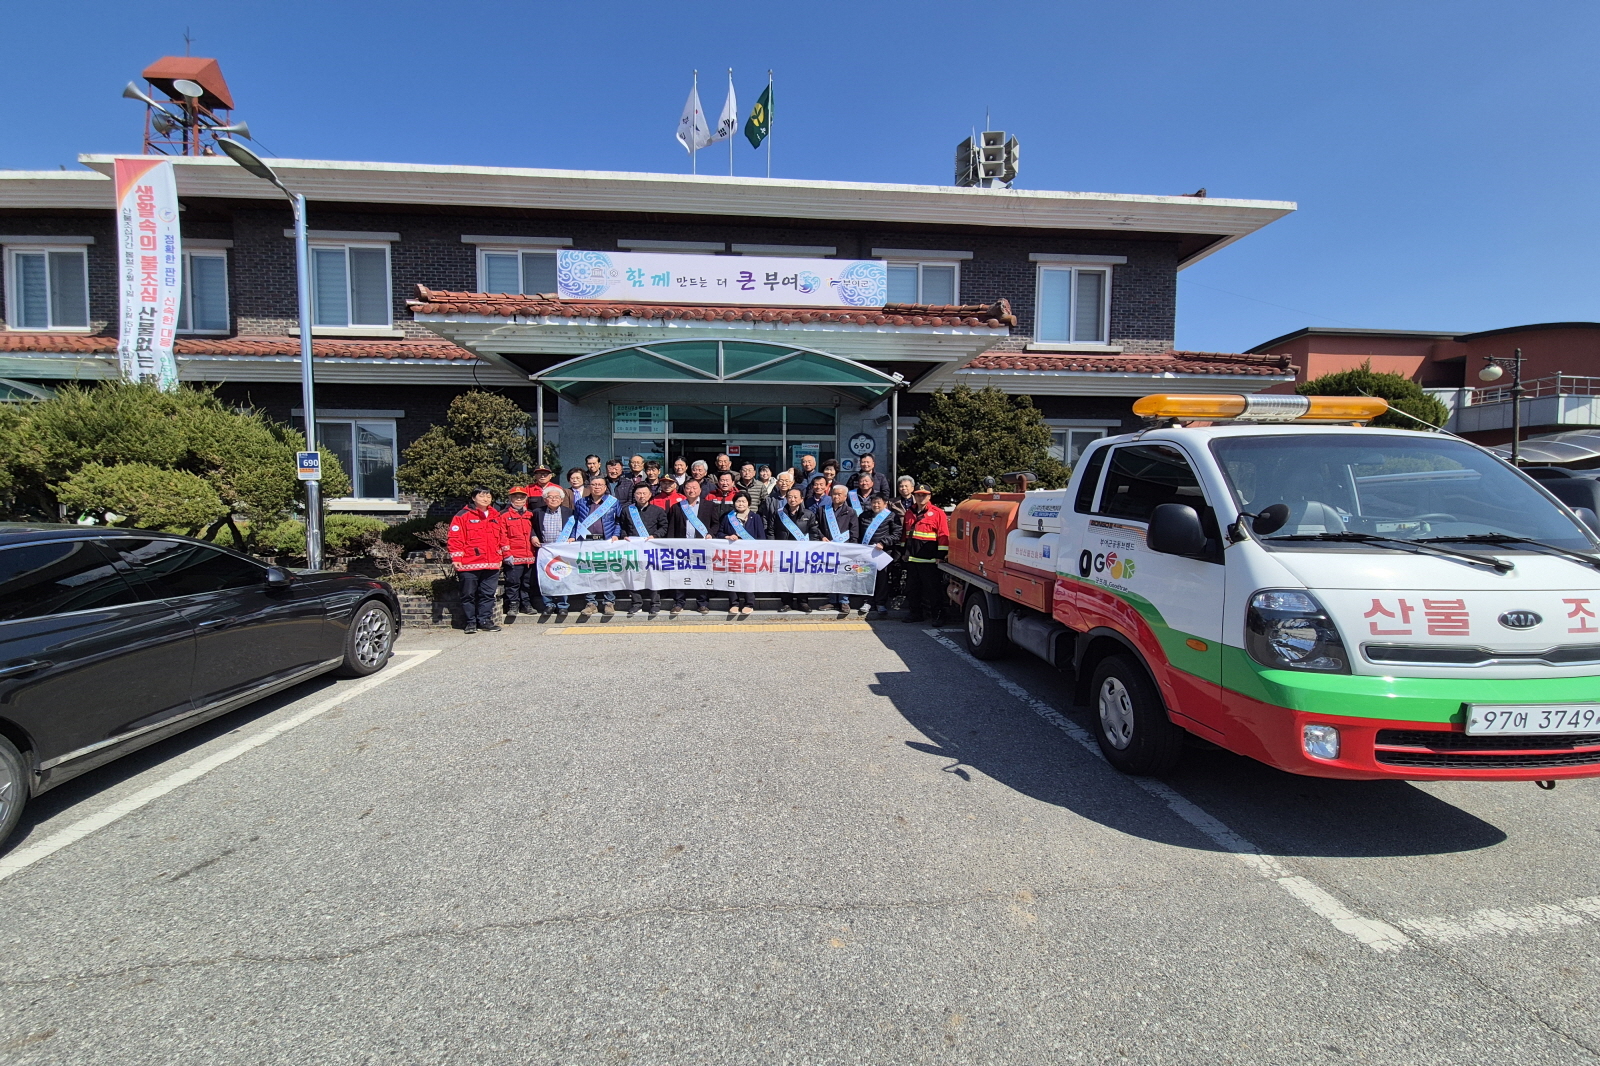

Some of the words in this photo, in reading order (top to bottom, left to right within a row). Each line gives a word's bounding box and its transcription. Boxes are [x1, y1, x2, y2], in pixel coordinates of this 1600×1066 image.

[134, 185, 158, 251] 생활속의
[164, 234, 175, 264] 정확한
[140, 255, 158, 303] 불조심
[164, 267, 175, 287] 판단
[625, 267, 671, 288] 함께
[676, 276, 708, 288] 만드는
[716, 277, 727, 288] 더
[736, 270, 757, 291] 큰
[763, 271, 799, 291] 부여
[162, 297, 175, 325] 신속한
[136, 306, 158, 368] 산불없는
[159, 328, 173, 348] 대응
[853, 442, 871, 450] 690
[303, 459, 318, 467] 690
[575, 549, 640, 574] 산불방지
[643, 548, 707, 571] 계절없고
[711, 549, 774, 574] 산불감시
[779, 550, 841, 575] 너나없다
[1363, 598, 1470, 636] 산불
[1507, 613, 1538, 627] KIA
[1562, 598, 1599, 634] 조
[1483, 711, 1528, 730] 97어
[1538, 709, 1595, 729] 3749
